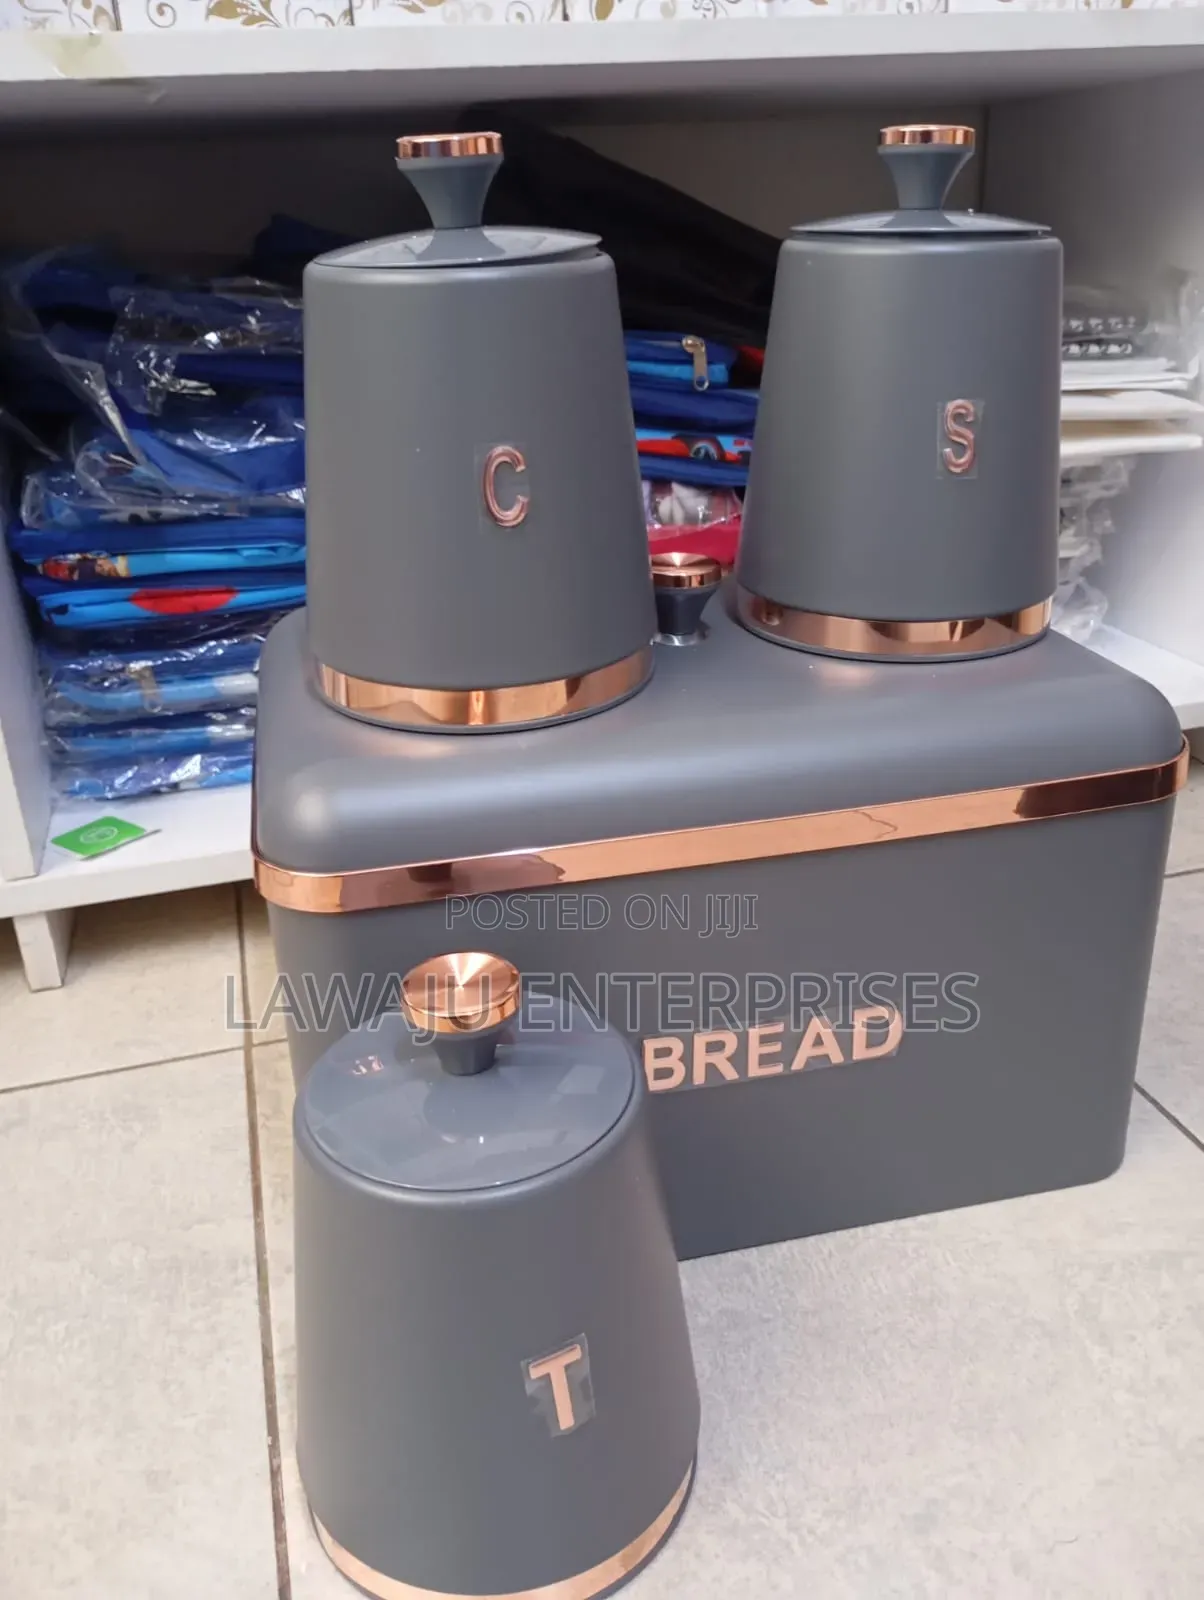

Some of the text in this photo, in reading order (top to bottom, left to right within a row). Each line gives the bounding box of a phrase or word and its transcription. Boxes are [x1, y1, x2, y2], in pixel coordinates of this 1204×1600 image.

[944, 399, 975, 474] S
[483, 445, 528, 528] C
[643, 1004, 904, 1093] BREAD
[528, 1343, 582, 1431] T
